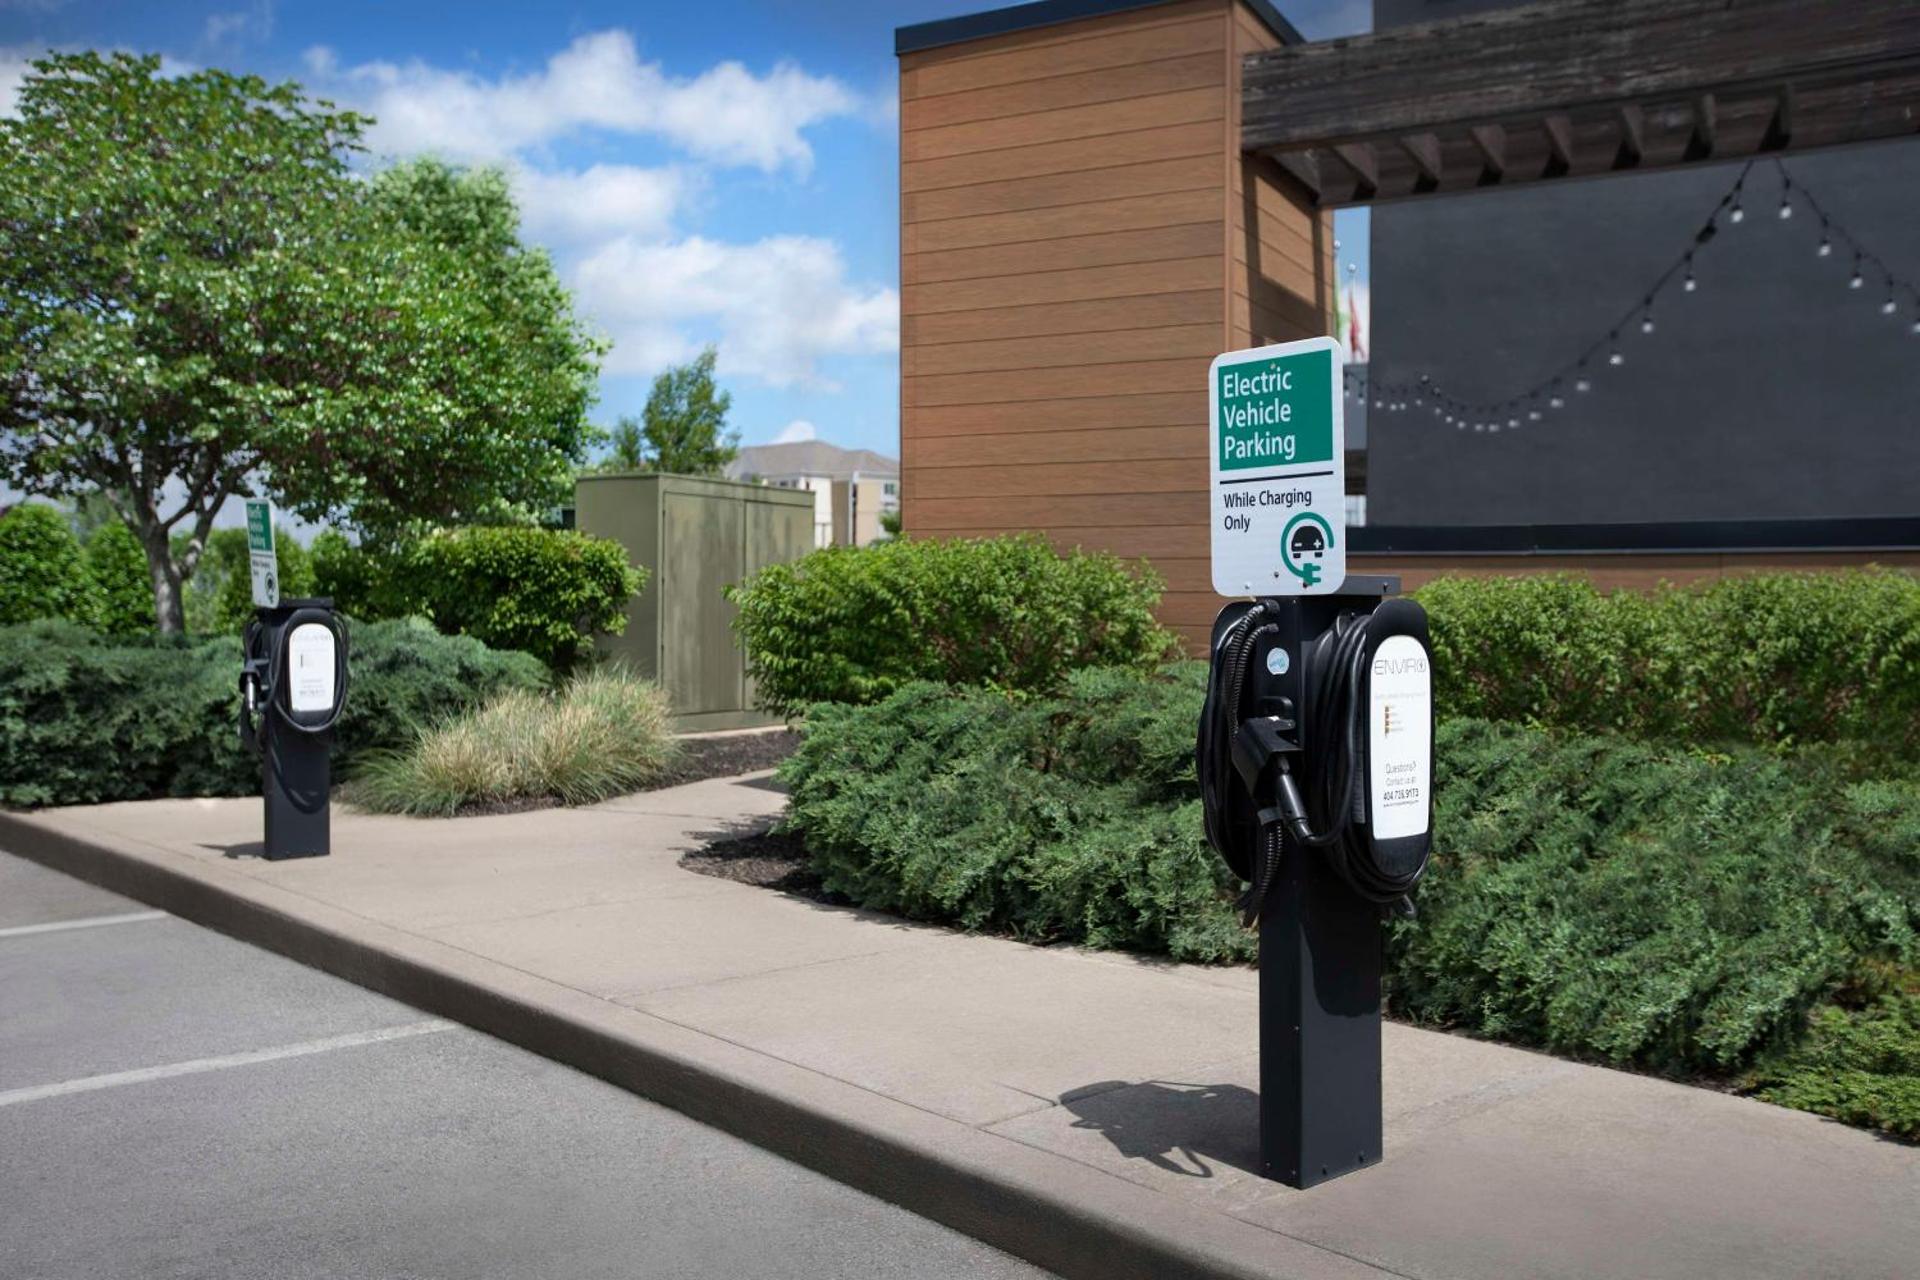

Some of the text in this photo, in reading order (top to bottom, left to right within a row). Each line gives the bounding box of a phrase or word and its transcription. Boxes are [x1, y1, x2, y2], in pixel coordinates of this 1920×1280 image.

[1223, 368, 1292, 398] Electric
[1223, 398, 1291, 429] Vehicle
[1224, 431, 1296, 460] Parking
[1223, 488, 1312, 508] While Charging
[1224, 514, 1251, 533] Only
